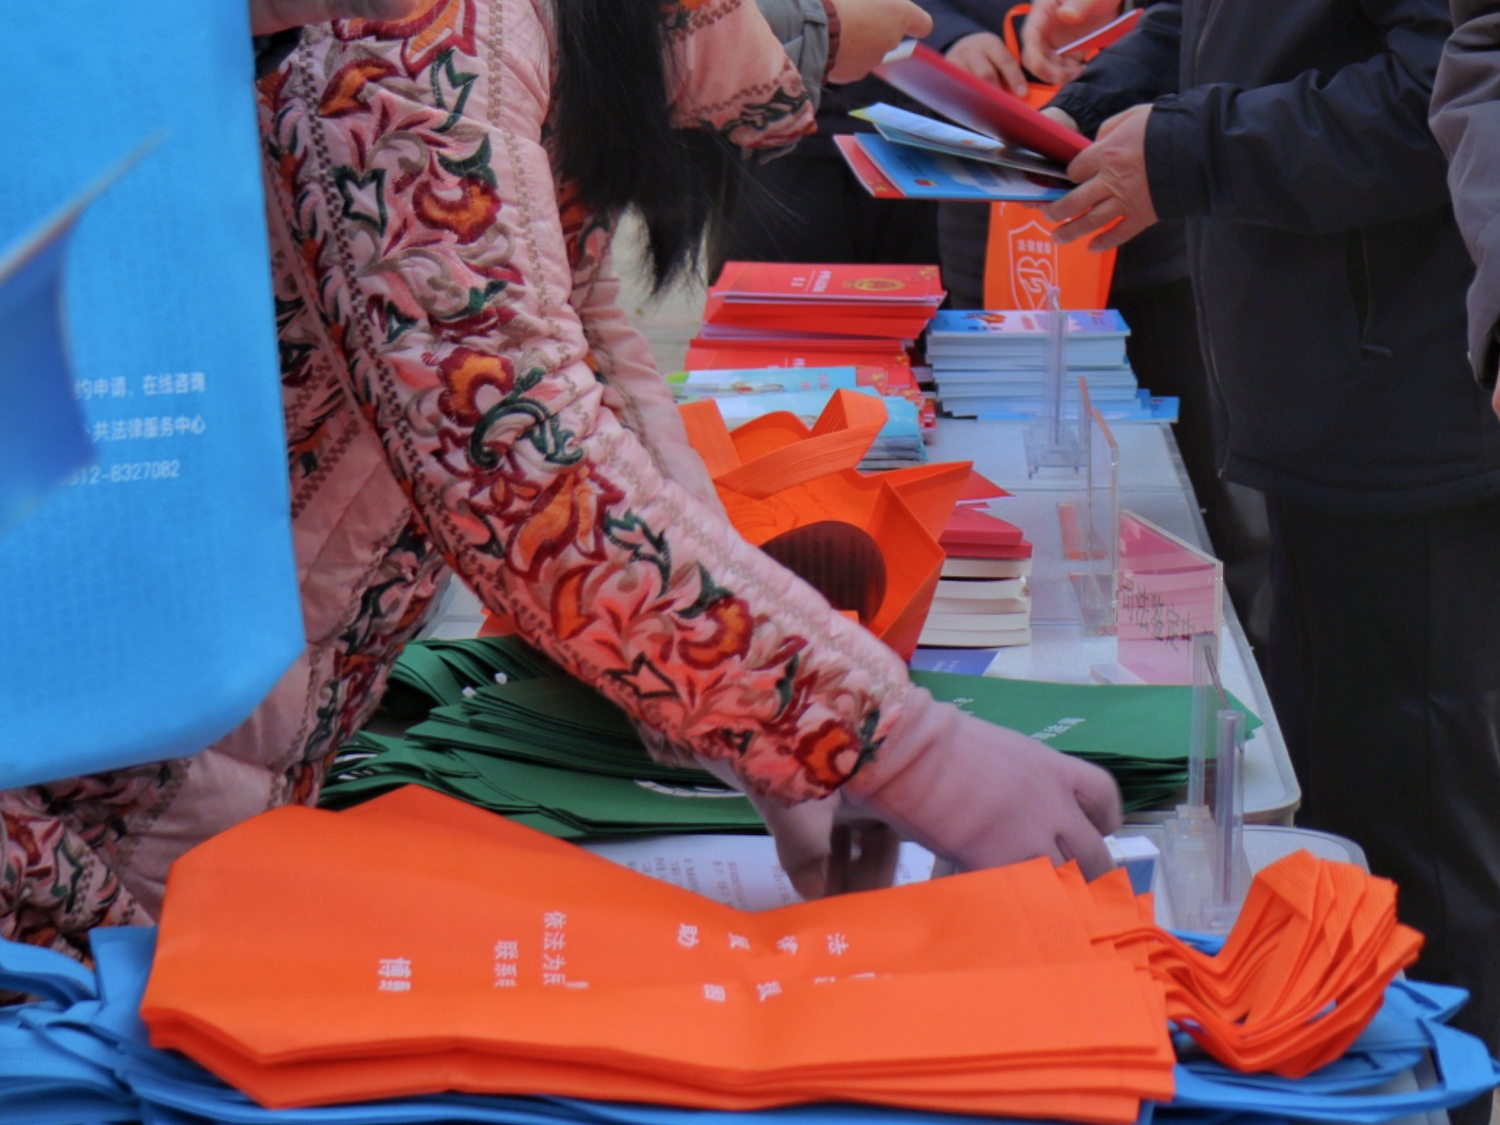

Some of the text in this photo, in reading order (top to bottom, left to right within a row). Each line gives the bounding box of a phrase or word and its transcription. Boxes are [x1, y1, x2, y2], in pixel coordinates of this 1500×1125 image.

[85, 414, 206, 443] 共法律服务中心
[65, 459, 181, 485] 312-8327082
[1121, 577, 1208, 660] 司法鉴定中
